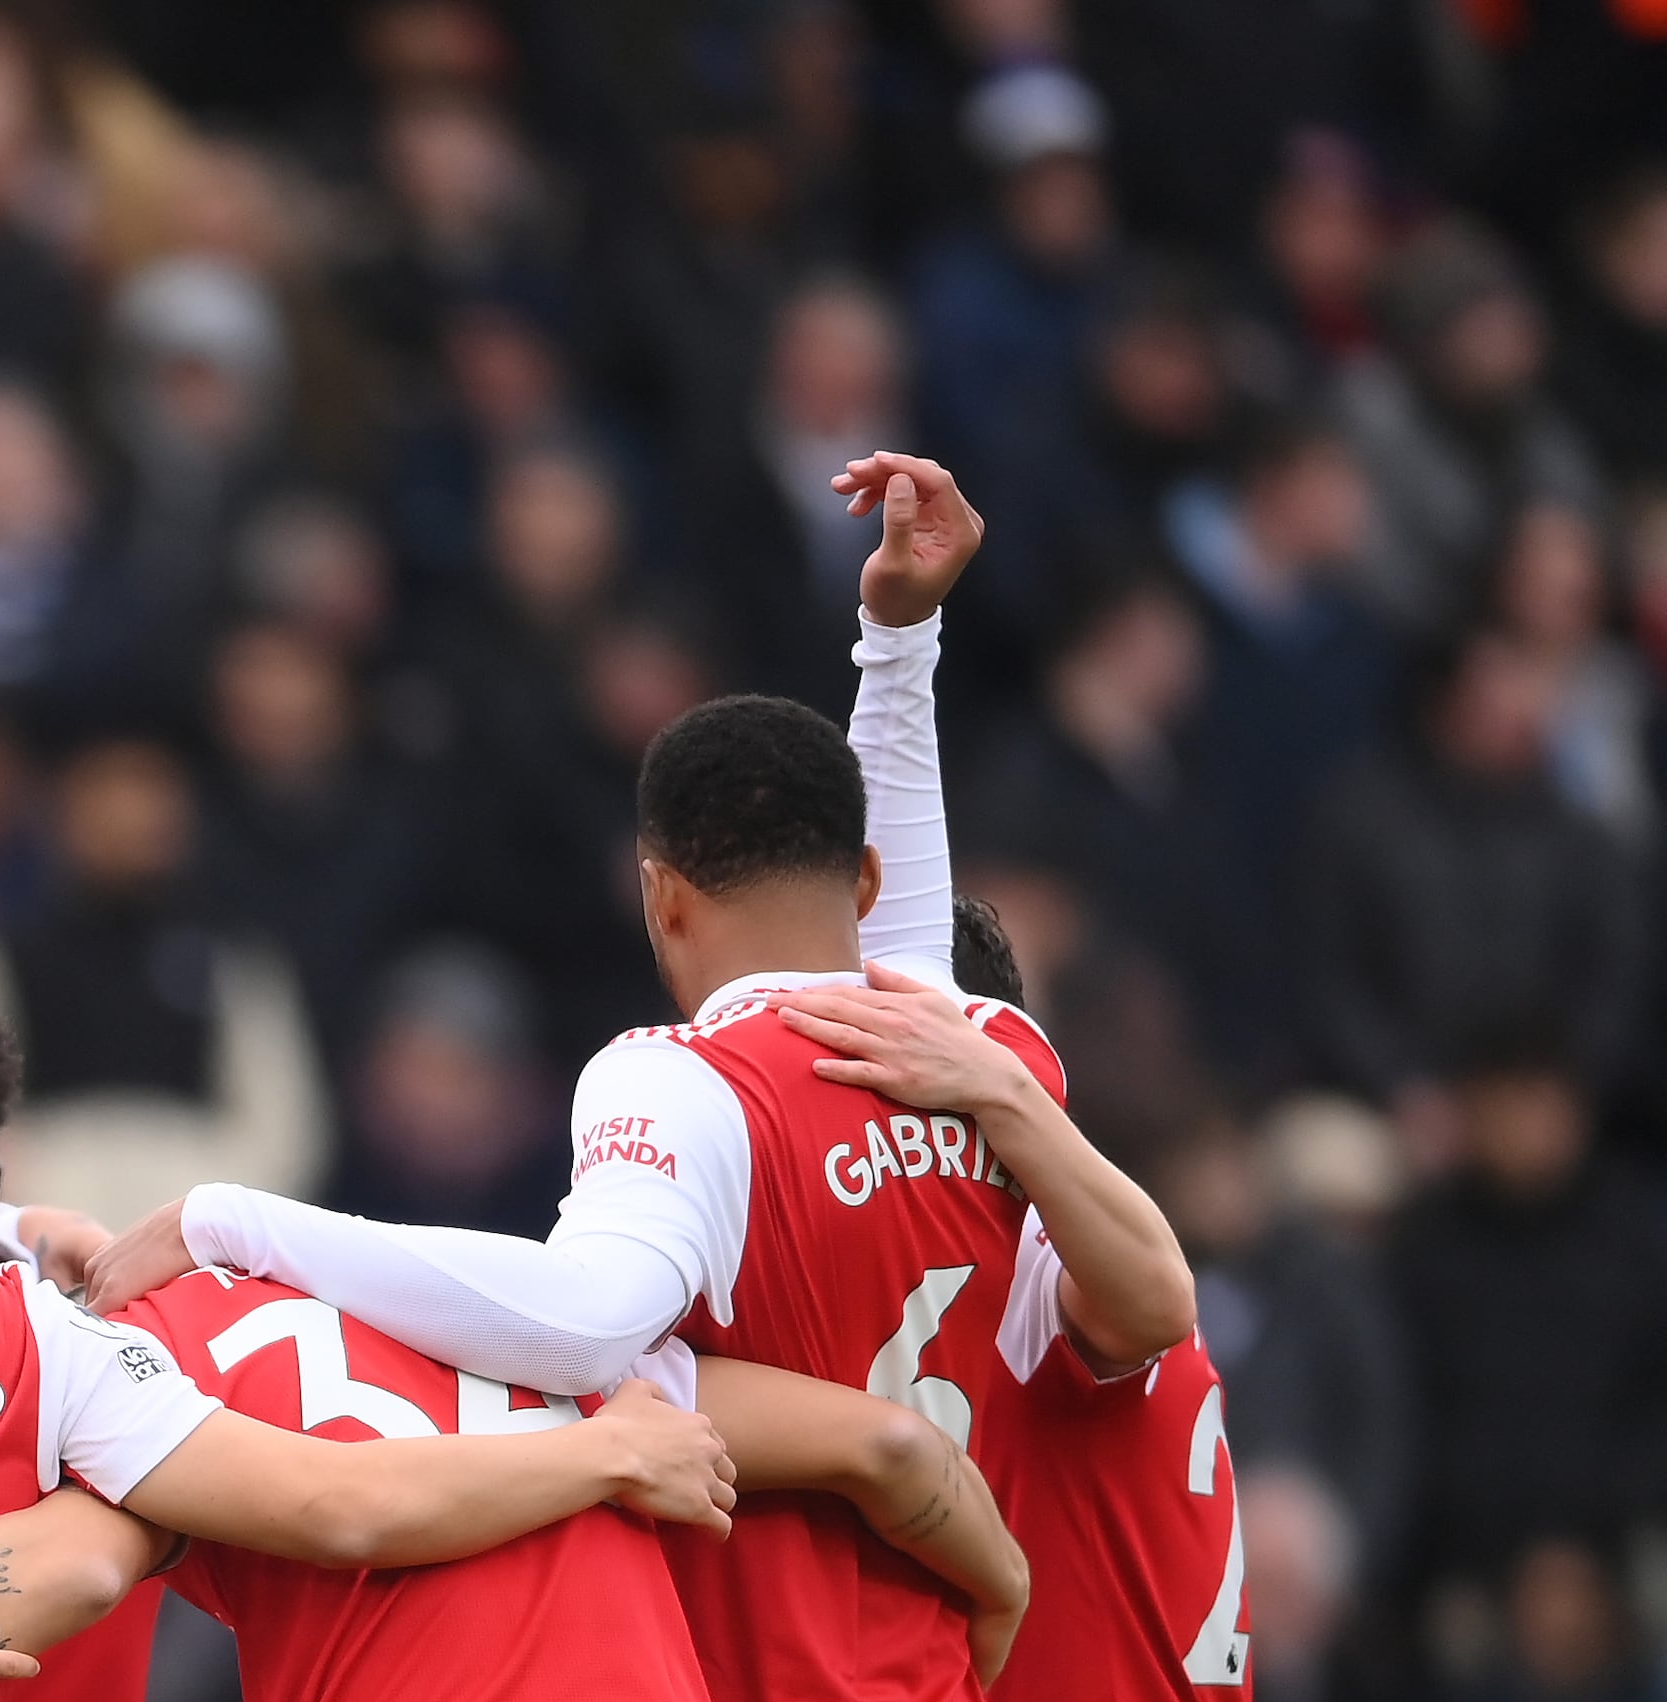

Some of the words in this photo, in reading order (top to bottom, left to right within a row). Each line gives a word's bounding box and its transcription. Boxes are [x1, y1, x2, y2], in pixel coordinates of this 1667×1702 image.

[582, 1116, 656, 1149] VISIT
[573, 1140, 677, 1183] WANDA
[1181, 1382, 1251, 1686] 2
